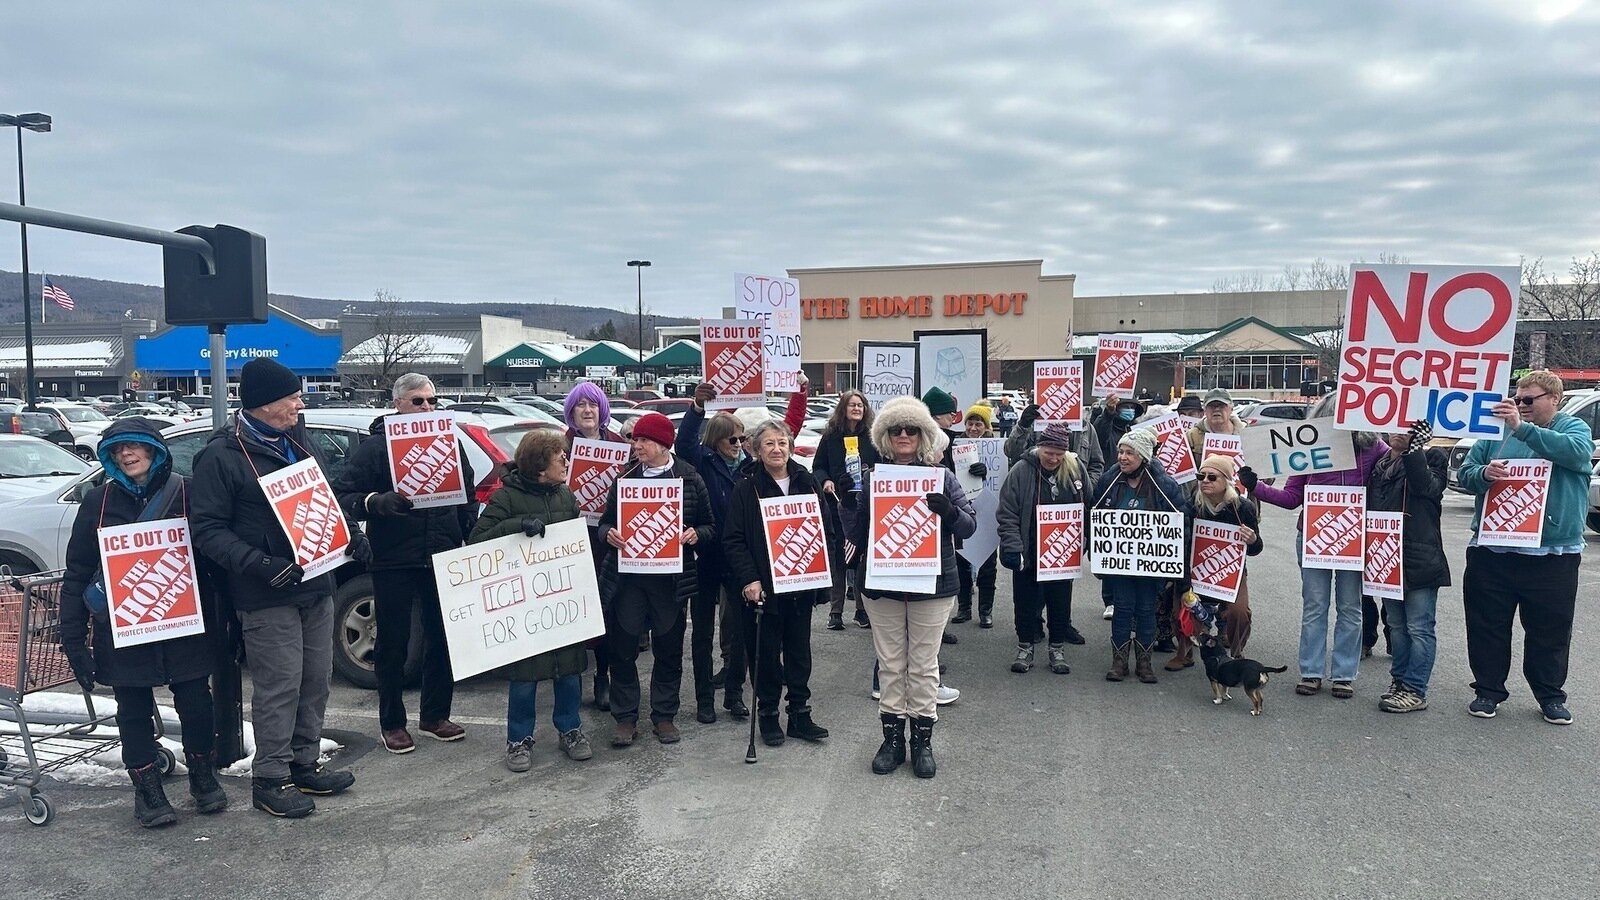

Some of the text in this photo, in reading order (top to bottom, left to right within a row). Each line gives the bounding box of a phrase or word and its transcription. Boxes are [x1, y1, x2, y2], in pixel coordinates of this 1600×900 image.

[744, 276, 795, 308] STOP
[801, 293, 1027, 319] THE HOME DEPOT
[1349, 271, 1512, 346] NO
[704, 327, 761, 338] ICE OUT OF
[1100, 339, 1111, 347] ICE
[1114, 340, 1128, 348] OUT
[200, 348, 278, 360] Grery & Home
[711, 347, 734, 369] THE
[1101, 354, 1118, 368] THE
[707, 342, 761, 393] HOME
[728, 361, 762, 394] DEPOT
[1037, 367, 1080, 376] ICE OUT OF
[1096, 351, 1138, 387] HOME
[1110, 365, 1135, 388] DEPOT
[1341, 347, 1509, 391] SECRET
[864, 383, 911, 395] DEMOCRACY
[1036, 377, 1080, 420] HOME
[1041, 382, 1059, 399] THE
[1054, 393, 1080, 420] DEPOT
[1337, 384, 1502, 434] POLICE
[389, 419, 452, 436] ICE OUT OF
[1153, 417, 1178, 432] UT OF
[1270, 424, 1318, 449] NO
[400, 443, 425, 468] THE
[575, 445, 627, 461] ICE OUT OF
[1158, 432, 1183, 468] OME
[1206, 439, 1239, 449] ICE OUT
[397, 435, 455, 496] HOME
[1269, 447, 1333, 475] ICE
[1510, 466, 1548, 477] OUT OF
[266, 466, 320, 499] ICE OUT OF
[423, 456, 457, 494] DEPOT
[575, 466, 599, 485] THE
[874, 479, 936, 493] ICE OUT OF
[621, 487, 680, 498] ICE OUT OF
[1308, 492, 1363, 504] ICE OUT OF
[1484, 479, 1544, 531] HOME
[1492, 484, 1517, 506] THE
[626, 508, 652, 531] THE
[764, 502, 816, 517] ICE OUT OF
[880, 502, 906, 528] THE
[1040, 510, 1081, 520] ICE OUT OF
[1092, 511, 1169, 527] #ICE OUT! NO
[1312, 511, 1335, 530] THE
[1504, 499, 1542, 532] DEPOT
[298, 484, 331, 563] HOME
[624, 502, 679, 558] HOME
[775, 524, 796, 548] THE
[1094, 526, 1182, 540] NO TROOPS WAR
[1196, 525, 1210, 535] ICE
[1213, 528, 1231, 539] OUT
[1306, 506, 1362, 554] HOME
[1375, 519, 1389, 529] OUT
[1390, 520, 1400, 530] OF
[104, 528, 185, 552] ICE OUT OF
[644, 522, 679, 558] DEPOT
[774, 517, 820, 576] HOME
[899, 519, 937, 559] DEPOT
[1040, 522, 1081, 568] HOME
[1044, 527, 1062, 546] THE
[1094, 540, 1178, 558] NO ICE RAIDS!
[1327, 525, 1362, 556] DEPOT
[1366, 537, 1381, 556] THE
[447, 541, 586, 587] STOP THE VIOLENCE
[795, 536, 823, 574] DEPOT
[1056, 538, 1081, 568] DEPOT
[1192, 543, 1243, 581] HOME
[1198, 544, 1220, 560] THE
[1364, 533, 1400, 582] HOME
[118, 558, 151, 590] THE
[1101, 557, 1183, 574] #DUE PROCESS
[1209, 560, 1241, 585] DEPOT
[1377, 553, 1400, 584] DEPOT
[114, 547, 190, 625] HOME
[148, 572, 193, 621] DEPOT
[449, 564, 575, 622] GET ICE OUT
[117, 628, 144, 638] PROTECT
[144, 625, 157, 633] OUR
[482, 595, 587, 647] FOR GOOD!
